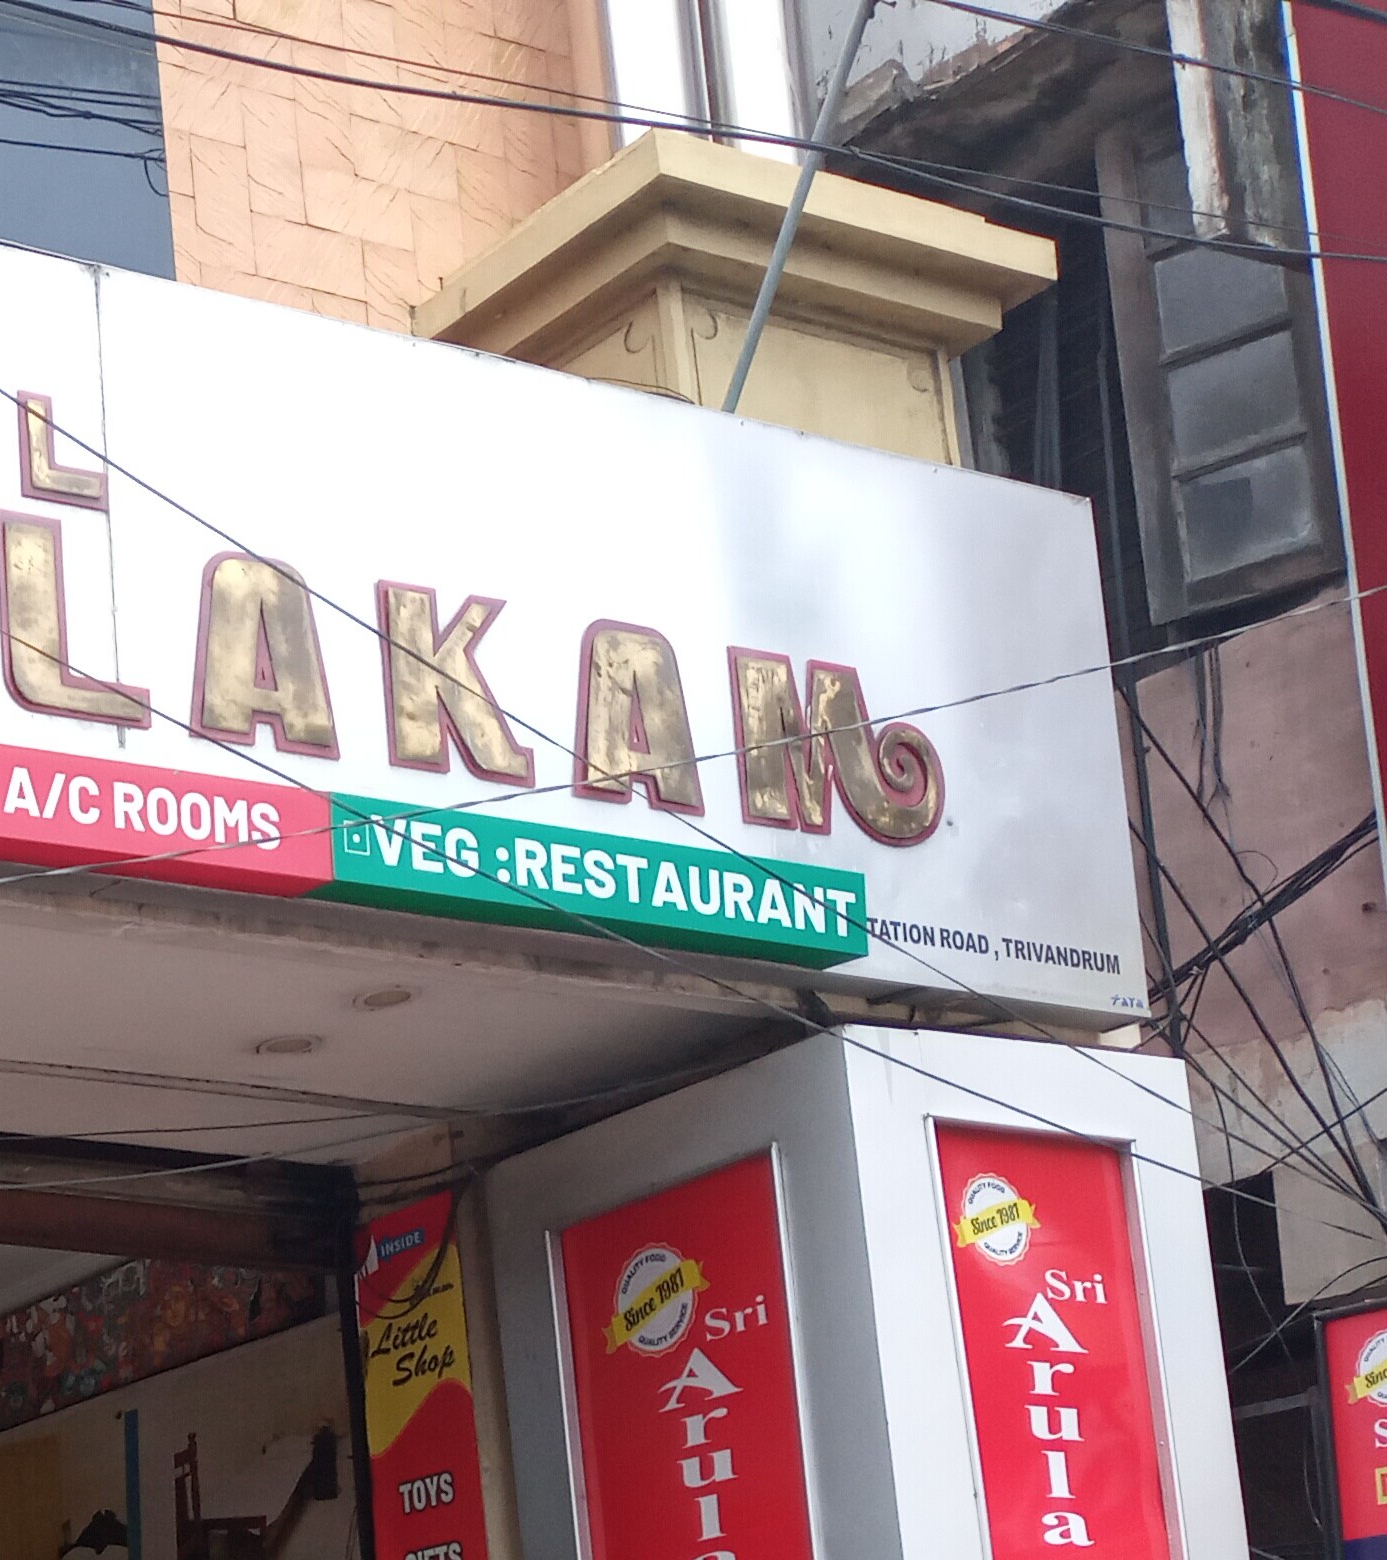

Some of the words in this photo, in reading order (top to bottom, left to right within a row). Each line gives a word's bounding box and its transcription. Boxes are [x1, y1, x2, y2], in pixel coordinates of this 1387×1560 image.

[4, 767, 100, 826] A/C
[114, 783, 283, 852] ROOMS
[370, 815, 481, 878] VEG
[1002, 938, 1122, 976] TRIVANDRUM
[971, 1216, 997, 1235] Since
[996, 1203, 1020, 1225] 1987
[380, 1231, 421, 1257] INSIDE
[624, 1298, 657, 1331] Since
[655, 1268, 684, 1304] 1987
[1044, 1269, 1107, 1305] Sri
[371, 1313, 438, 1358] Little
[705, 1295, 768, 1341] Sri
[392, 1345, 455, 1386] Shop
[400, 1473, 454, 1514] TOYS
